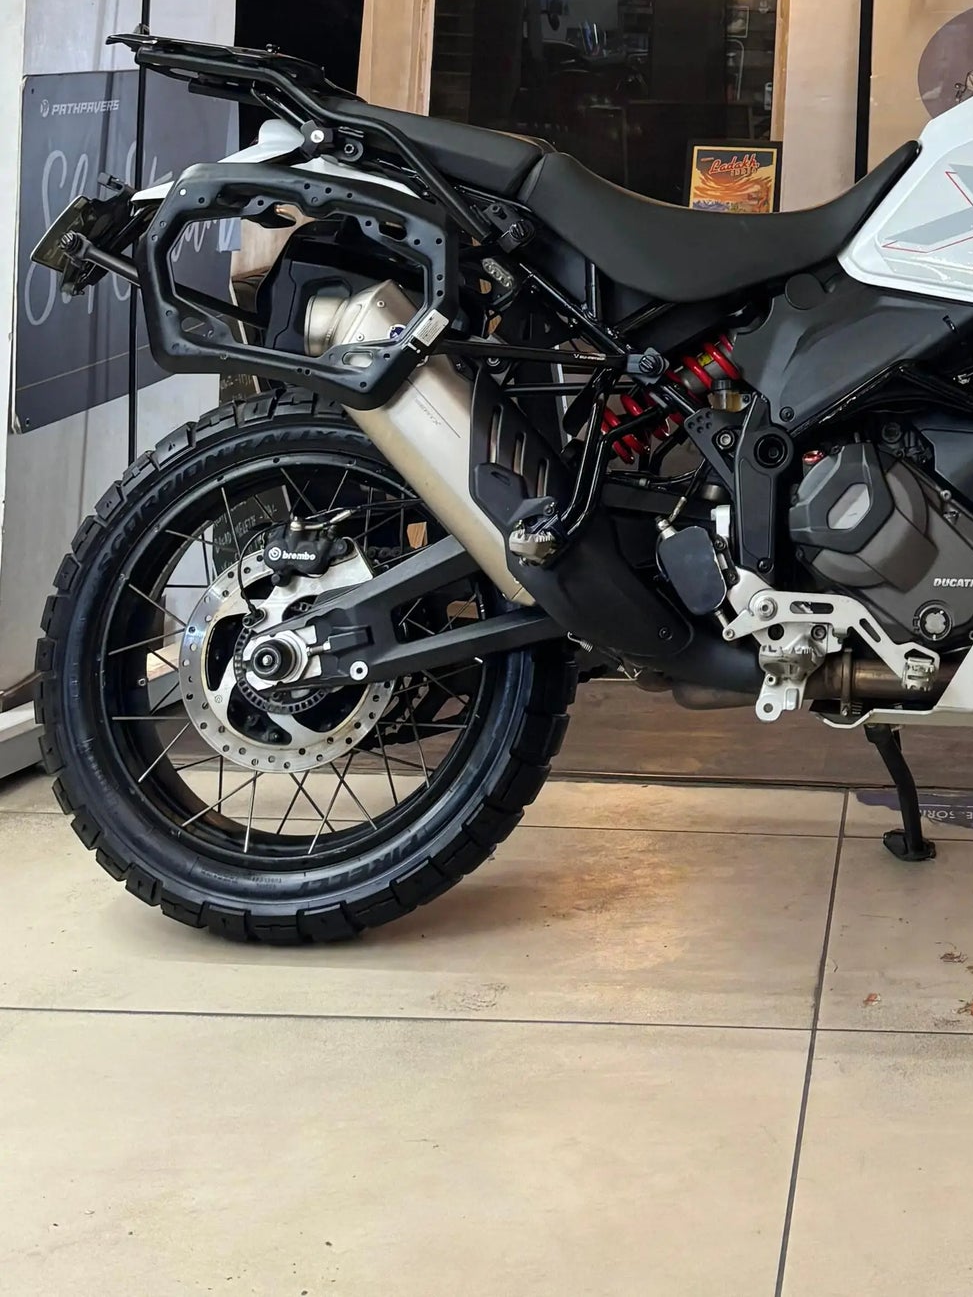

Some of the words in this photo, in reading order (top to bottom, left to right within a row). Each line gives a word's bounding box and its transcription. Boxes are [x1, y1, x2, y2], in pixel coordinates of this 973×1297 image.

[52, 99, 120, 116] PATHPAVERS
[708, 153, 757, 175] Ladakh
[282, 550, 316, 561] brembo
